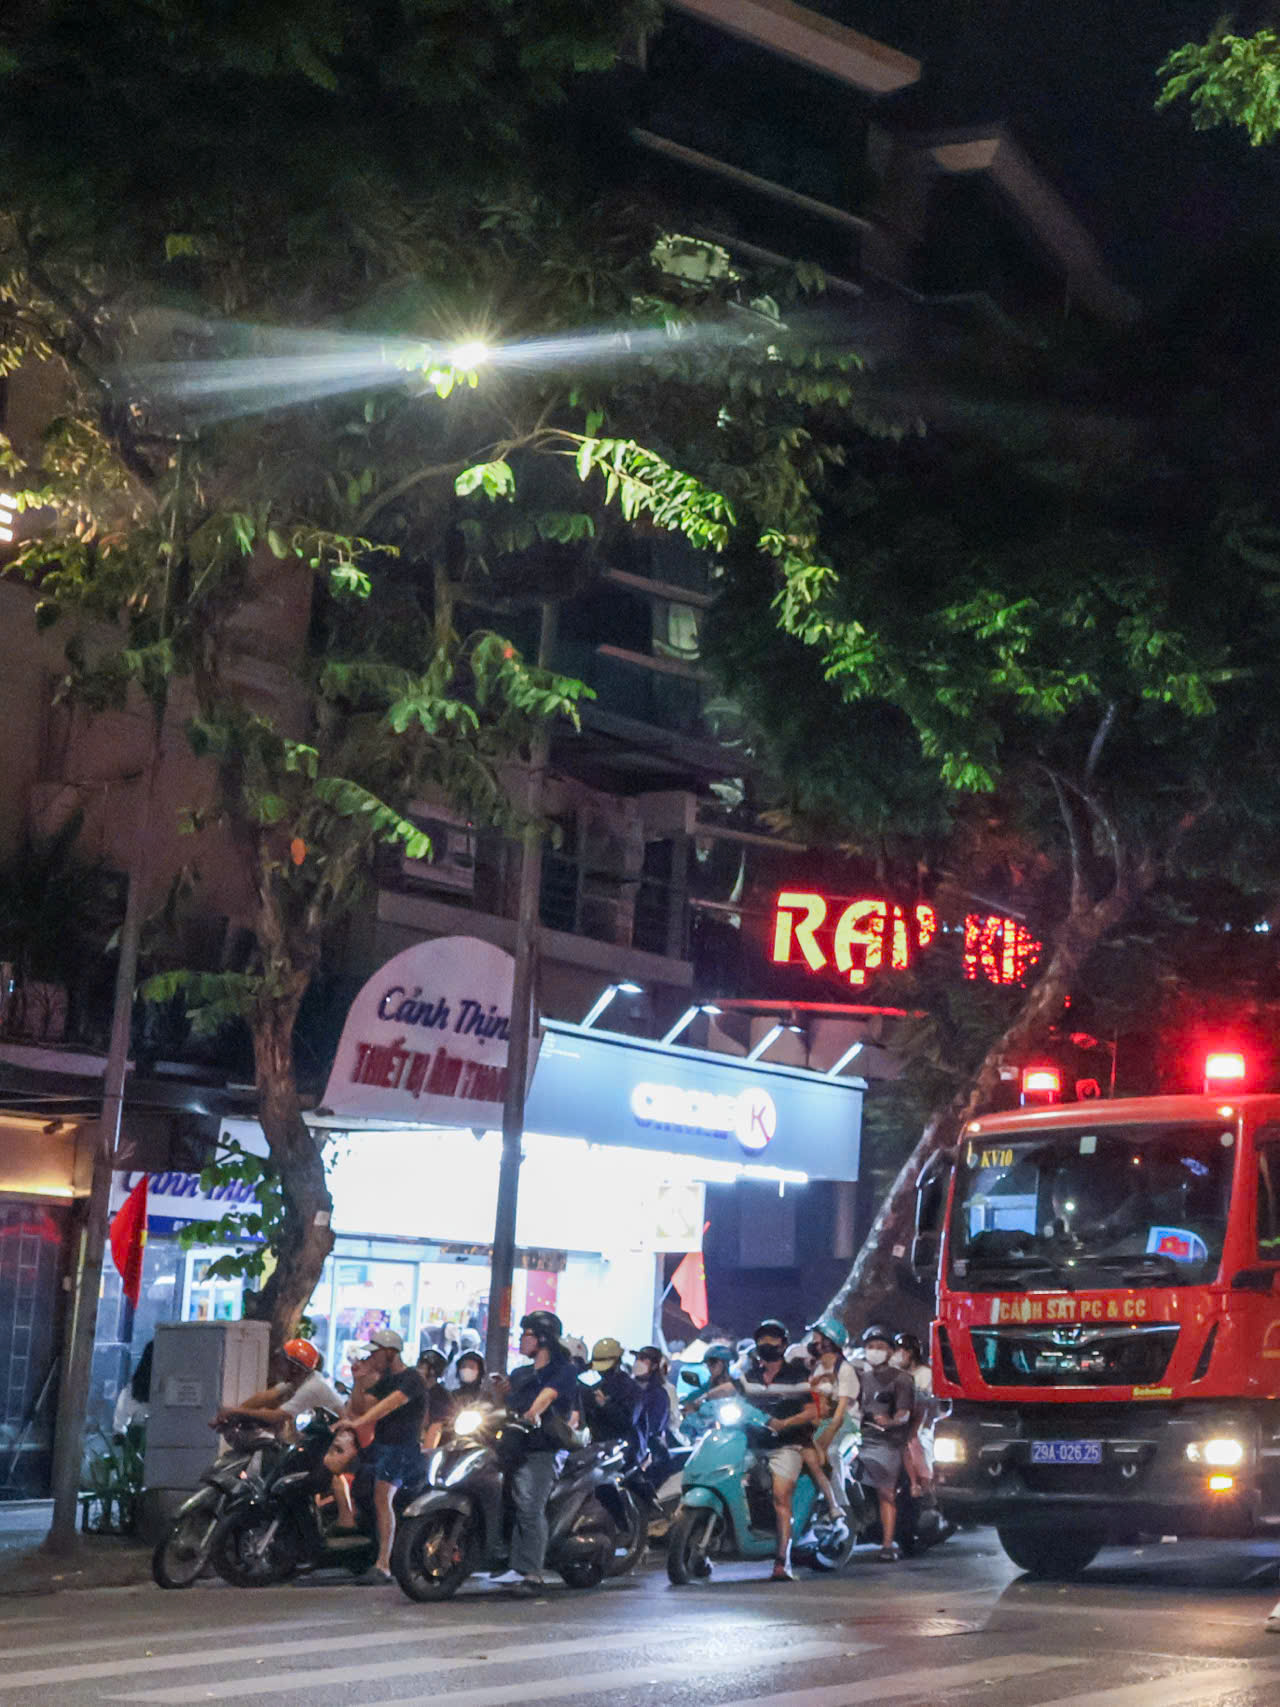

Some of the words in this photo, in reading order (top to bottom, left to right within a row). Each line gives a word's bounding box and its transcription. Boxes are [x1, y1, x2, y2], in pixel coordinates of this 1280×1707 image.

[377, 985, 450, 1030] Cảnh
[981, 1149, 1013, 1168] KV10
[1080, 1300, 1101, 1318] PC
[1107, 1300, 1118, 1318] &
[1123, 1299, 1147, 1317] CC
